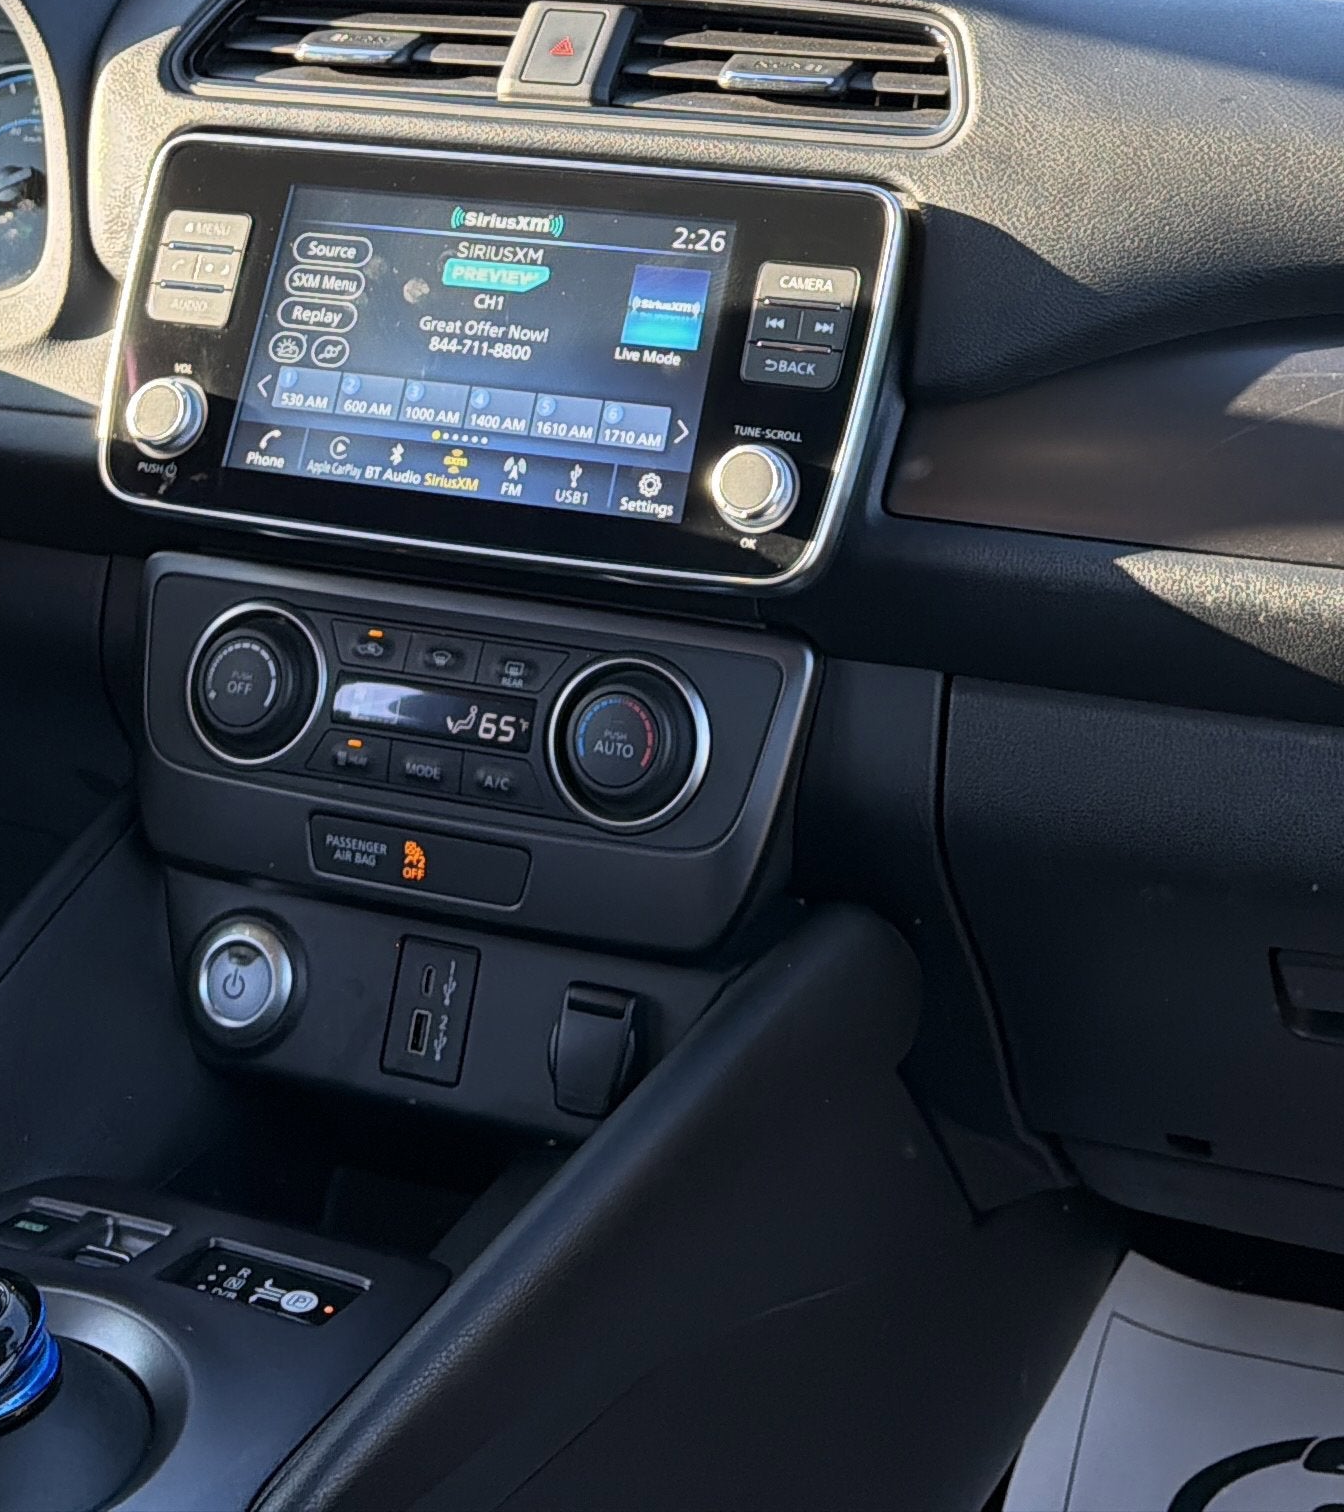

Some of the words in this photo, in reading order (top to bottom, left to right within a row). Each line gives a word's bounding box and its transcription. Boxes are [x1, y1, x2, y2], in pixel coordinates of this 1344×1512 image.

[196, 221, 231, 237] MENU
[670, 226, 728, 253] 2:26
[308, 240, 357, 261] Source
[456, 241, 545, 265] SIRIUSXM
[292, 271, 321, 289] SXM
[322, 274, 358, 293] Menu
[451, 267, 541, 286] PREVIEW
[779, 275, 834, 293] CAMERA
[170, 297, 208, 313] AUDIO
[473, 293, 505, 312] CH1
[291, 305, 343, 327] Replay
[419, 315, 462, 334] Great
[463, 319, 507, 339] Offer
[508, 323, 550, 344] Now!
[428, 336, 532, 362] 844-711-8800
[614, 347, 640, 364] Live
[642, 350, 682, 367] Mode
[174, 362, 193, 375] VOL
[778, 361, 817, 376] BACK
[281, 392, 304, 408] 530
[305, 394, 329, 410] AM
[344, 399, 367, 414] 600
[368, 402, 392, 417] AM
[406, 406, 435, 422] 1000
[435, 409, 460, 425] AM
[470, 413, 501, 430] 1400
[502, 416, 527, 433] AM
[536, 420, 568, 438] 1610
[569, 424, 594, 440] AM
[604, 428, 636, 445] 1710
[637, 432, 662, 448] AM
[137, 461, 164, 475] PUSH
[245, 451, 286, 469] Phone
[307, 459, 332, 476] Apple
[332, 461, 362, 480] CarPlay
[364, 466, 382, 480] BT
[383, 468, 422, 485] Audio
[424, 472, 480, 492] SiriusXM
[500, 481, 523, 498] FM
[554, 489, 589, 506] USB1
[619, 496, 674, 519] Settings
[740, 537, 758, 551] OK
[227, 680, 253, 696] OFF
[501, 676, 524, 689] REAR
[604, 728, 628, 741] PUSH
[593, 740, 634, 759] AUTO
[405, 761, 441, 780] MODE
[484, 774, 510, 791] A/C
[326, 834, 388, 856] PASSENGER
[333, 848, 353, 863] AIR
[354, 852, 377, 868] BAG
[402, 866, 425, 881] OFF
[237, 1266, 253, 1280] R
